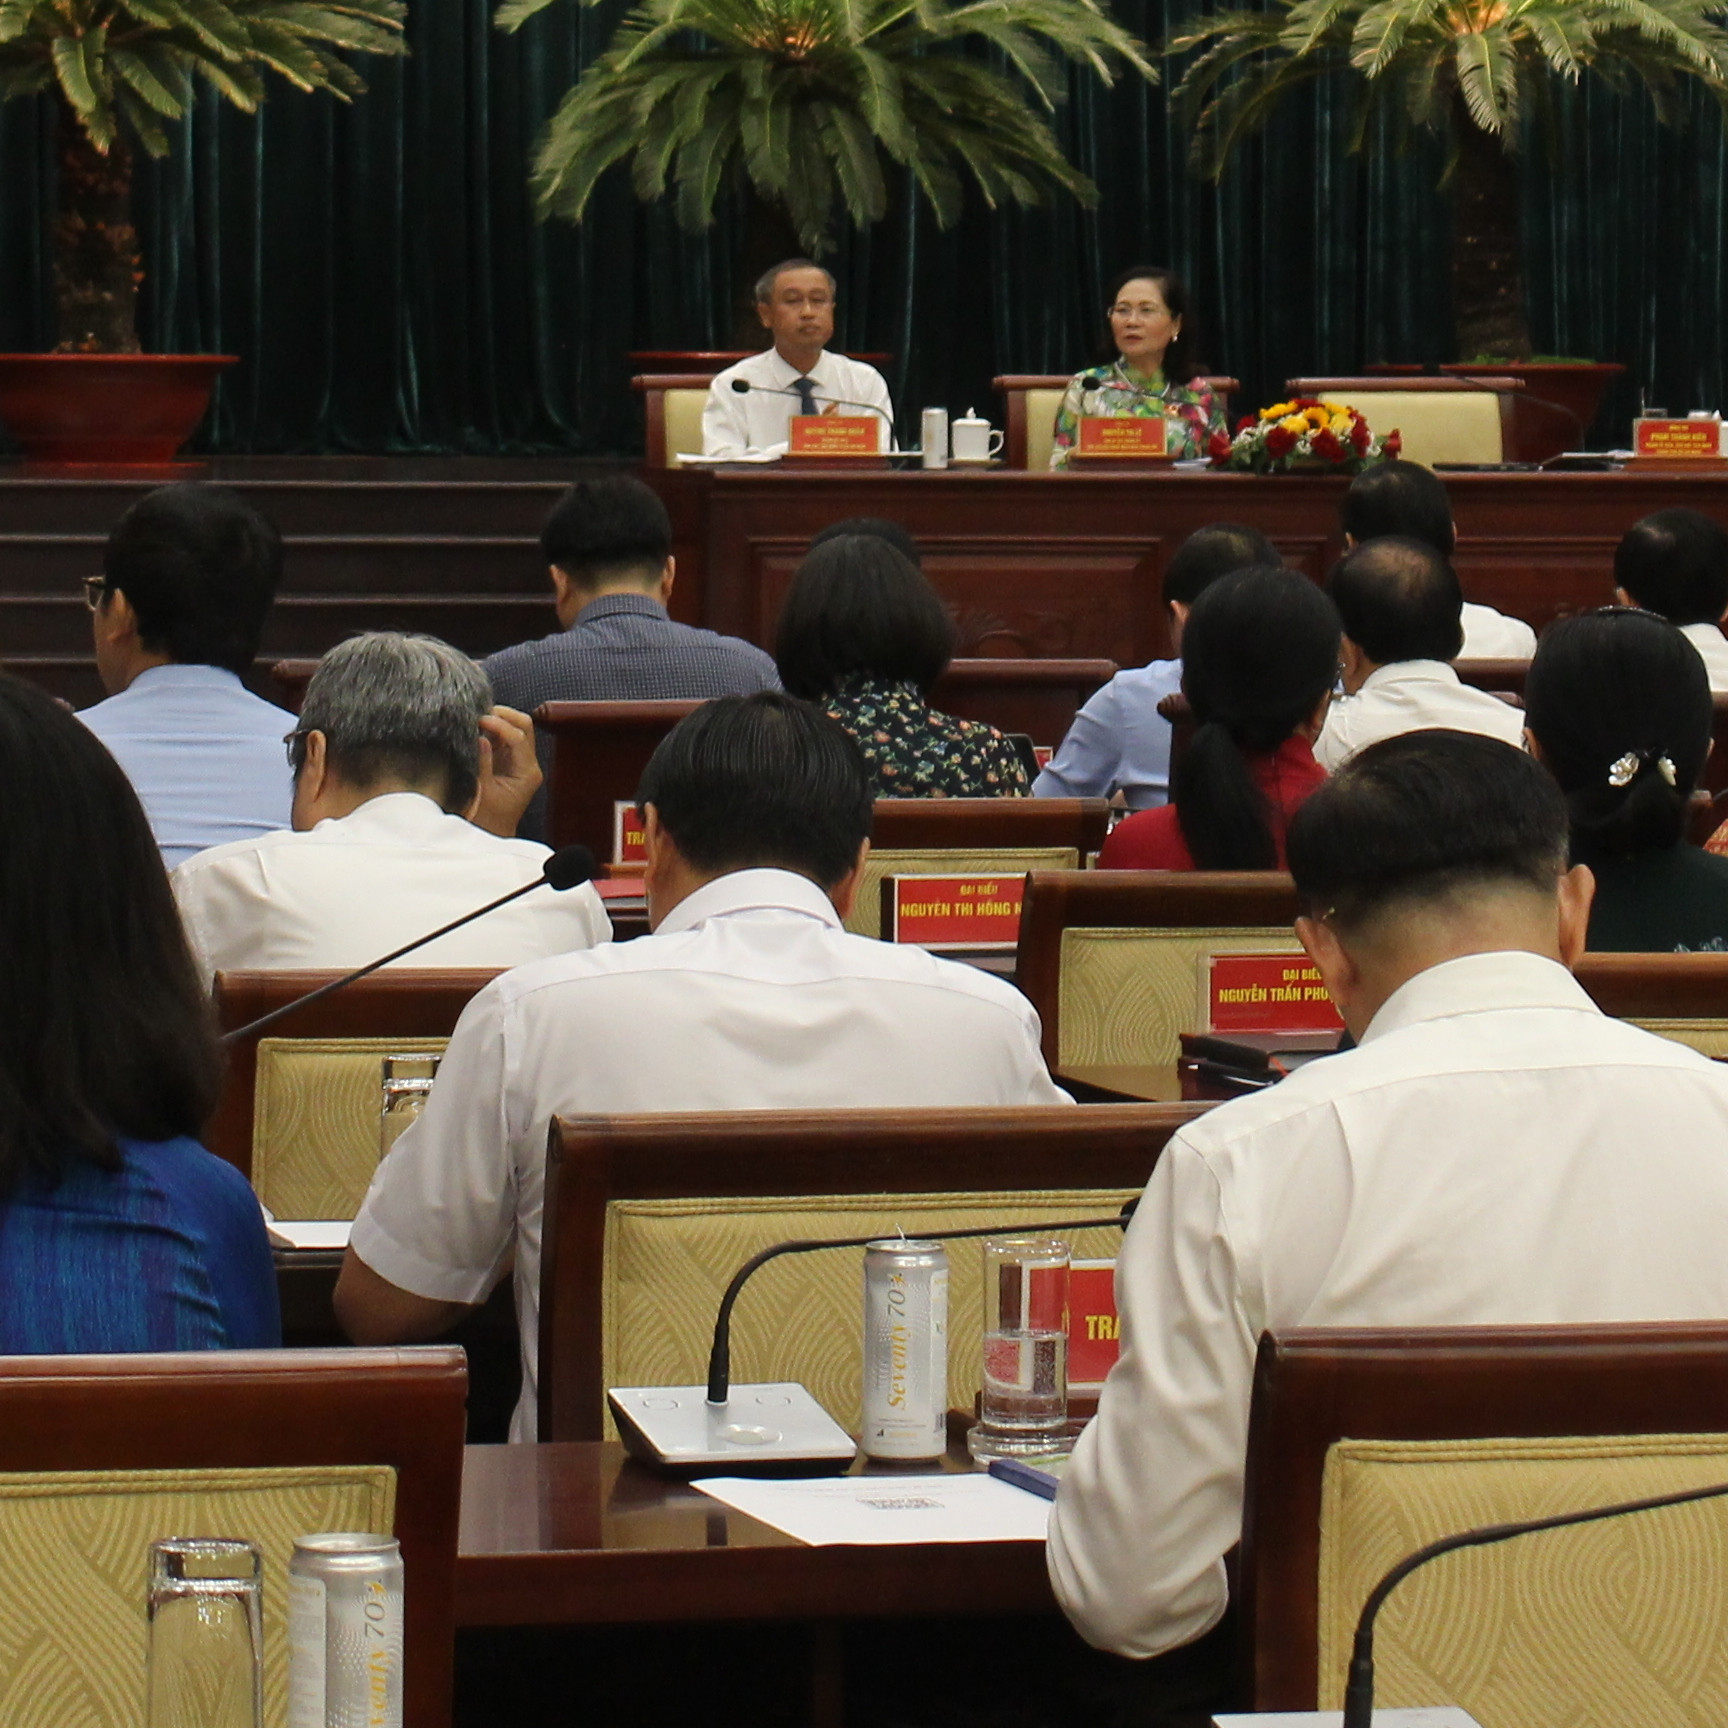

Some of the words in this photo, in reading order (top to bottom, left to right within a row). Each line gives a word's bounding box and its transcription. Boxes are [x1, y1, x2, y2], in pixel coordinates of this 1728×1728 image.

[887, 1289, 907, 1319] 70
[887, 1325, 911, 1410] Seventy
[364, 1602, 385, 1638] 70
